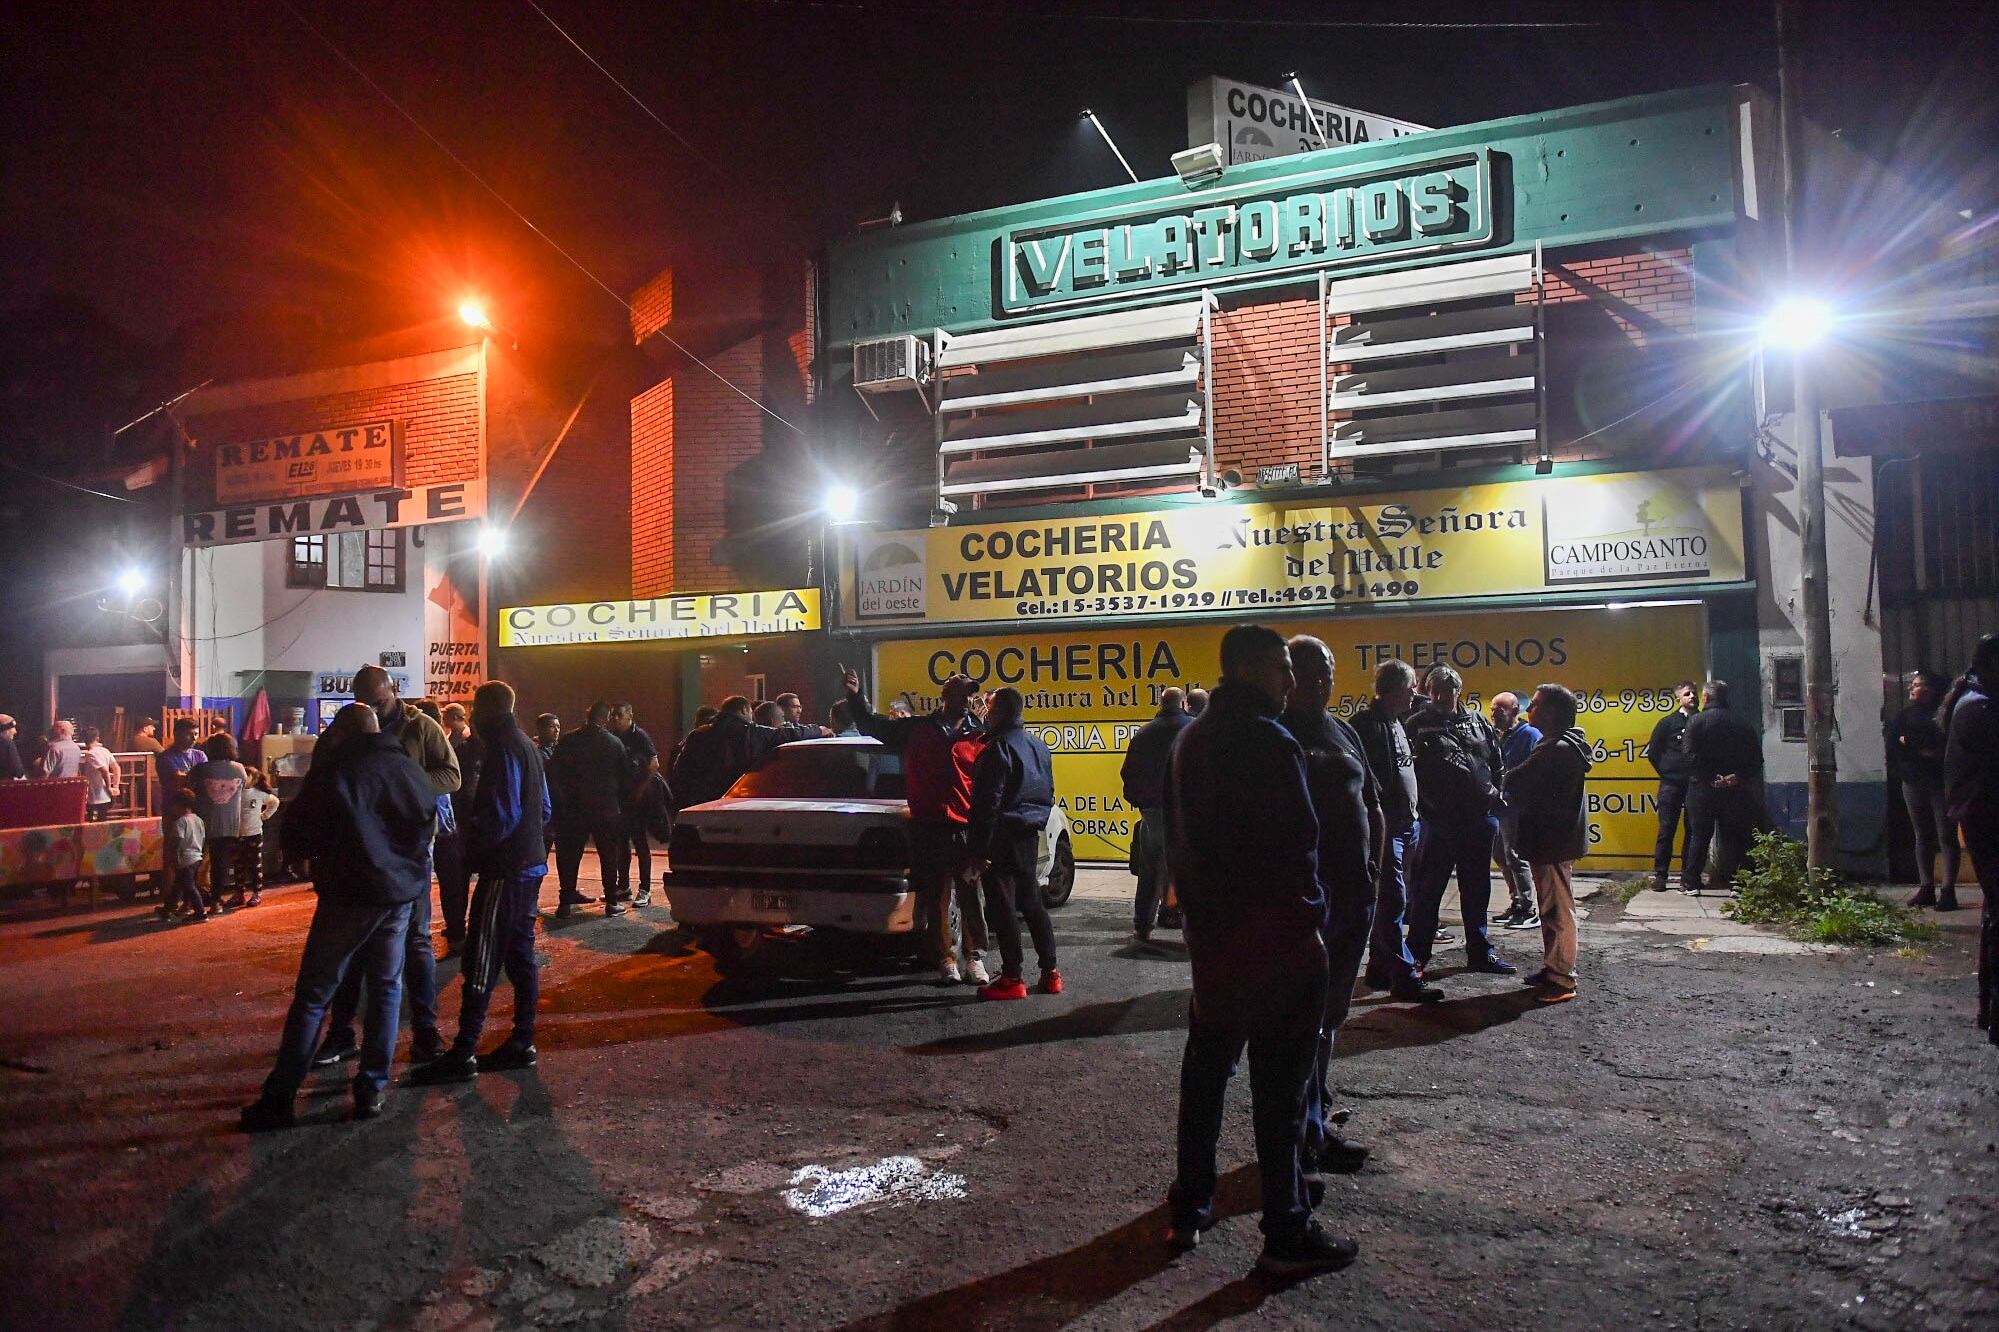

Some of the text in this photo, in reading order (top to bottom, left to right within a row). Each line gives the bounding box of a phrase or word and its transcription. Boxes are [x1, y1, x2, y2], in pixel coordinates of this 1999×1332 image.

[1227, 87, 1370, 144] COCHERIA
[1233, 149, 1266, 161] JARD
[1018, 172, 1455, 294] VELATORIOS
[221, 424, 387, 466] REMATE
[184, 484, 465, 544] REMATE
[1216, 504, 1527, 549] Nuestra Señora
[960, 519, 1172, 562] COCHERIA
[1550, 535, 1707, 564] CAMPOSANTO
[1286, 545, 1443, 578] del Valle
[1551, 560, 1708, 577] Parque de la Paz Eterna
[860, 576, 922, 596] JARDÍN
[941, 558, 1198, 602] VELATORIOS
[508, 591, 808, 630] COCHERIA
[862, 598, 920, 611] del oeste
[1016, 591, 1216, 615] Cel.:15-3537-1929
[1235, 580, 1419, 604] Tel.:4626-1490
[429, 642, 480, 656] PUERTA
[927, 640, 1181, 686] COCHERIA
[429, 680, 471, 695] REJAS
[1024, 688, 1094, 709] eñora
[1103, 684, 1138, 707] del
[1025, 725, 1106, 750] TORIA
[1075, 796, 1096, 811] DE
[1103, 796, 1123, 811] LA
[1588, 794, 1658, 814] BOLIV
[1072, 820, 1128, 835] OBRAS
